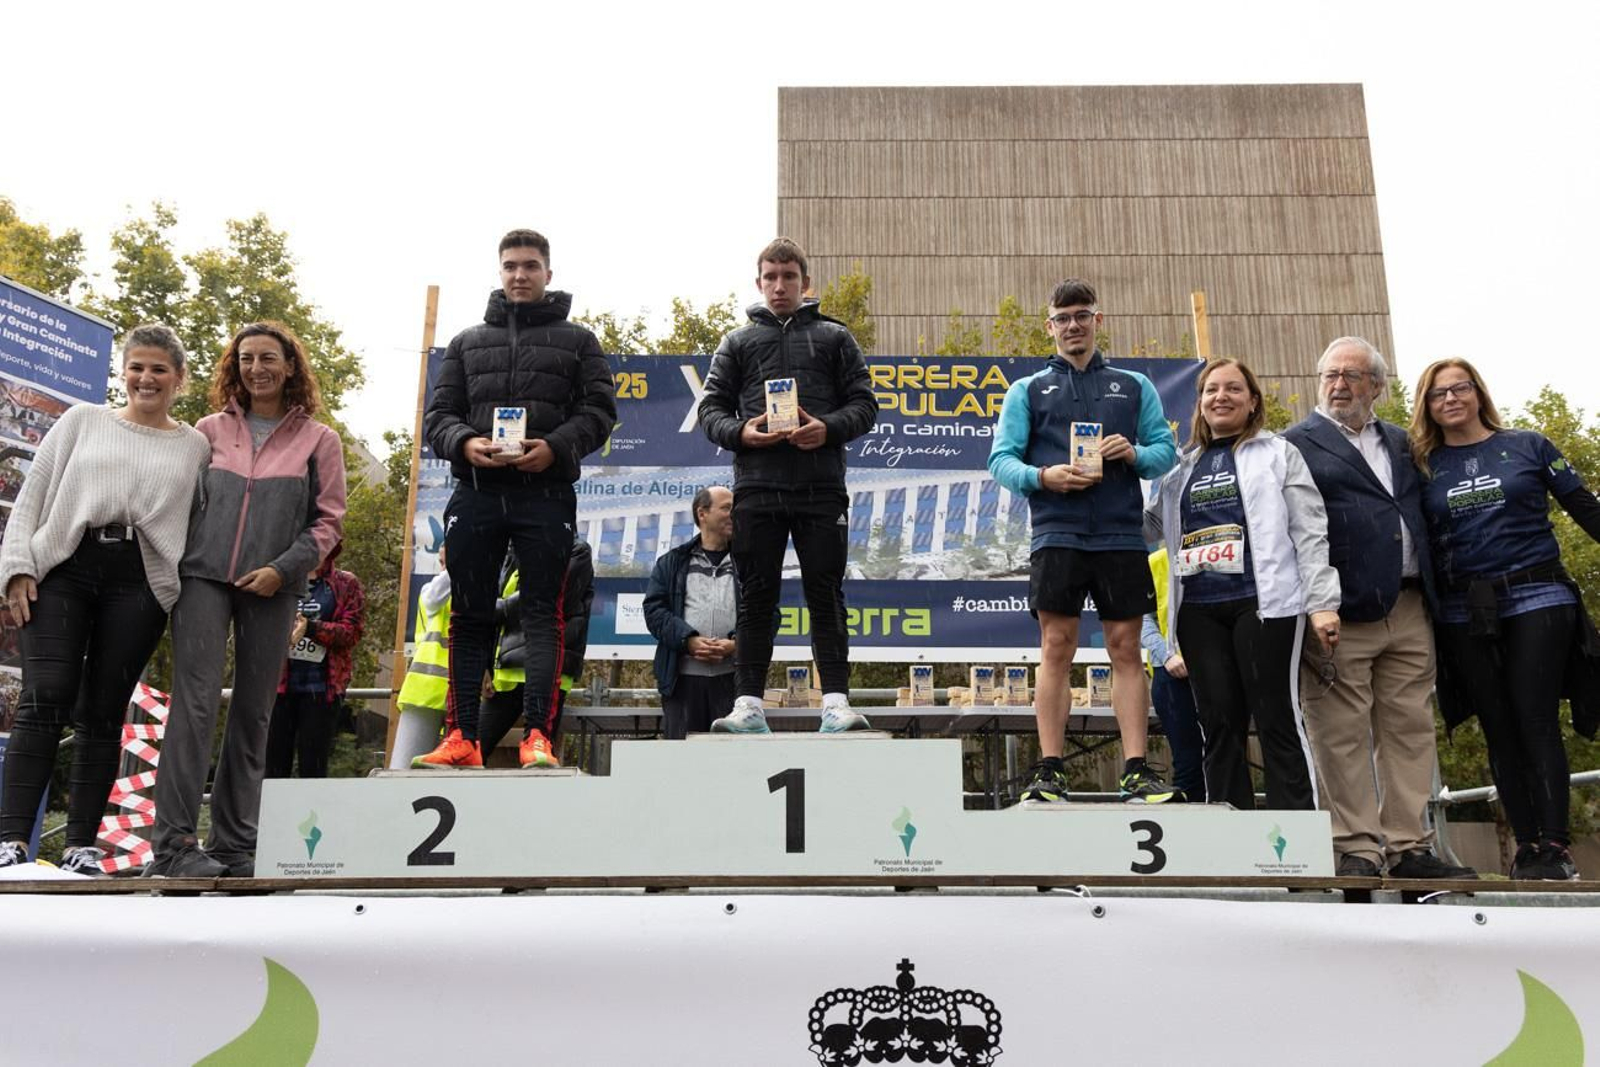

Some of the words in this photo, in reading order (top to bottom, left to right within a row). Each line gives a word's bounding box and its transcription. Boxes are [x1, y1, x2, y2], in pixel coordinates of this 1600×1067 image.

[0, 299, 38, 320] rsario
[39, 314, 54, 326] de
[55, 319, 67, 332] la
[3, 328, 73, 363] Integración
[7, 315, 38, 335] Gran
[39, 328, 97, 358] Caminata
[34, 364, 53, 376] vida
[60, 373, 92, 390] valores
[611, 372, 648, 399] 25
[768, 380, 793, 393] XXV
[1075, 424, 1100, 437] XXV
[859, 437, 961, 467] Integración
[622, 481, 643, 495] de
[1190, 471, 1236, 492] 25
[1447, 475, 1502, 497] 25
[767, 768, 805, 854] 1
[407, 796, 456, 866] 2
[1130, 820, 1167, 874] 3
